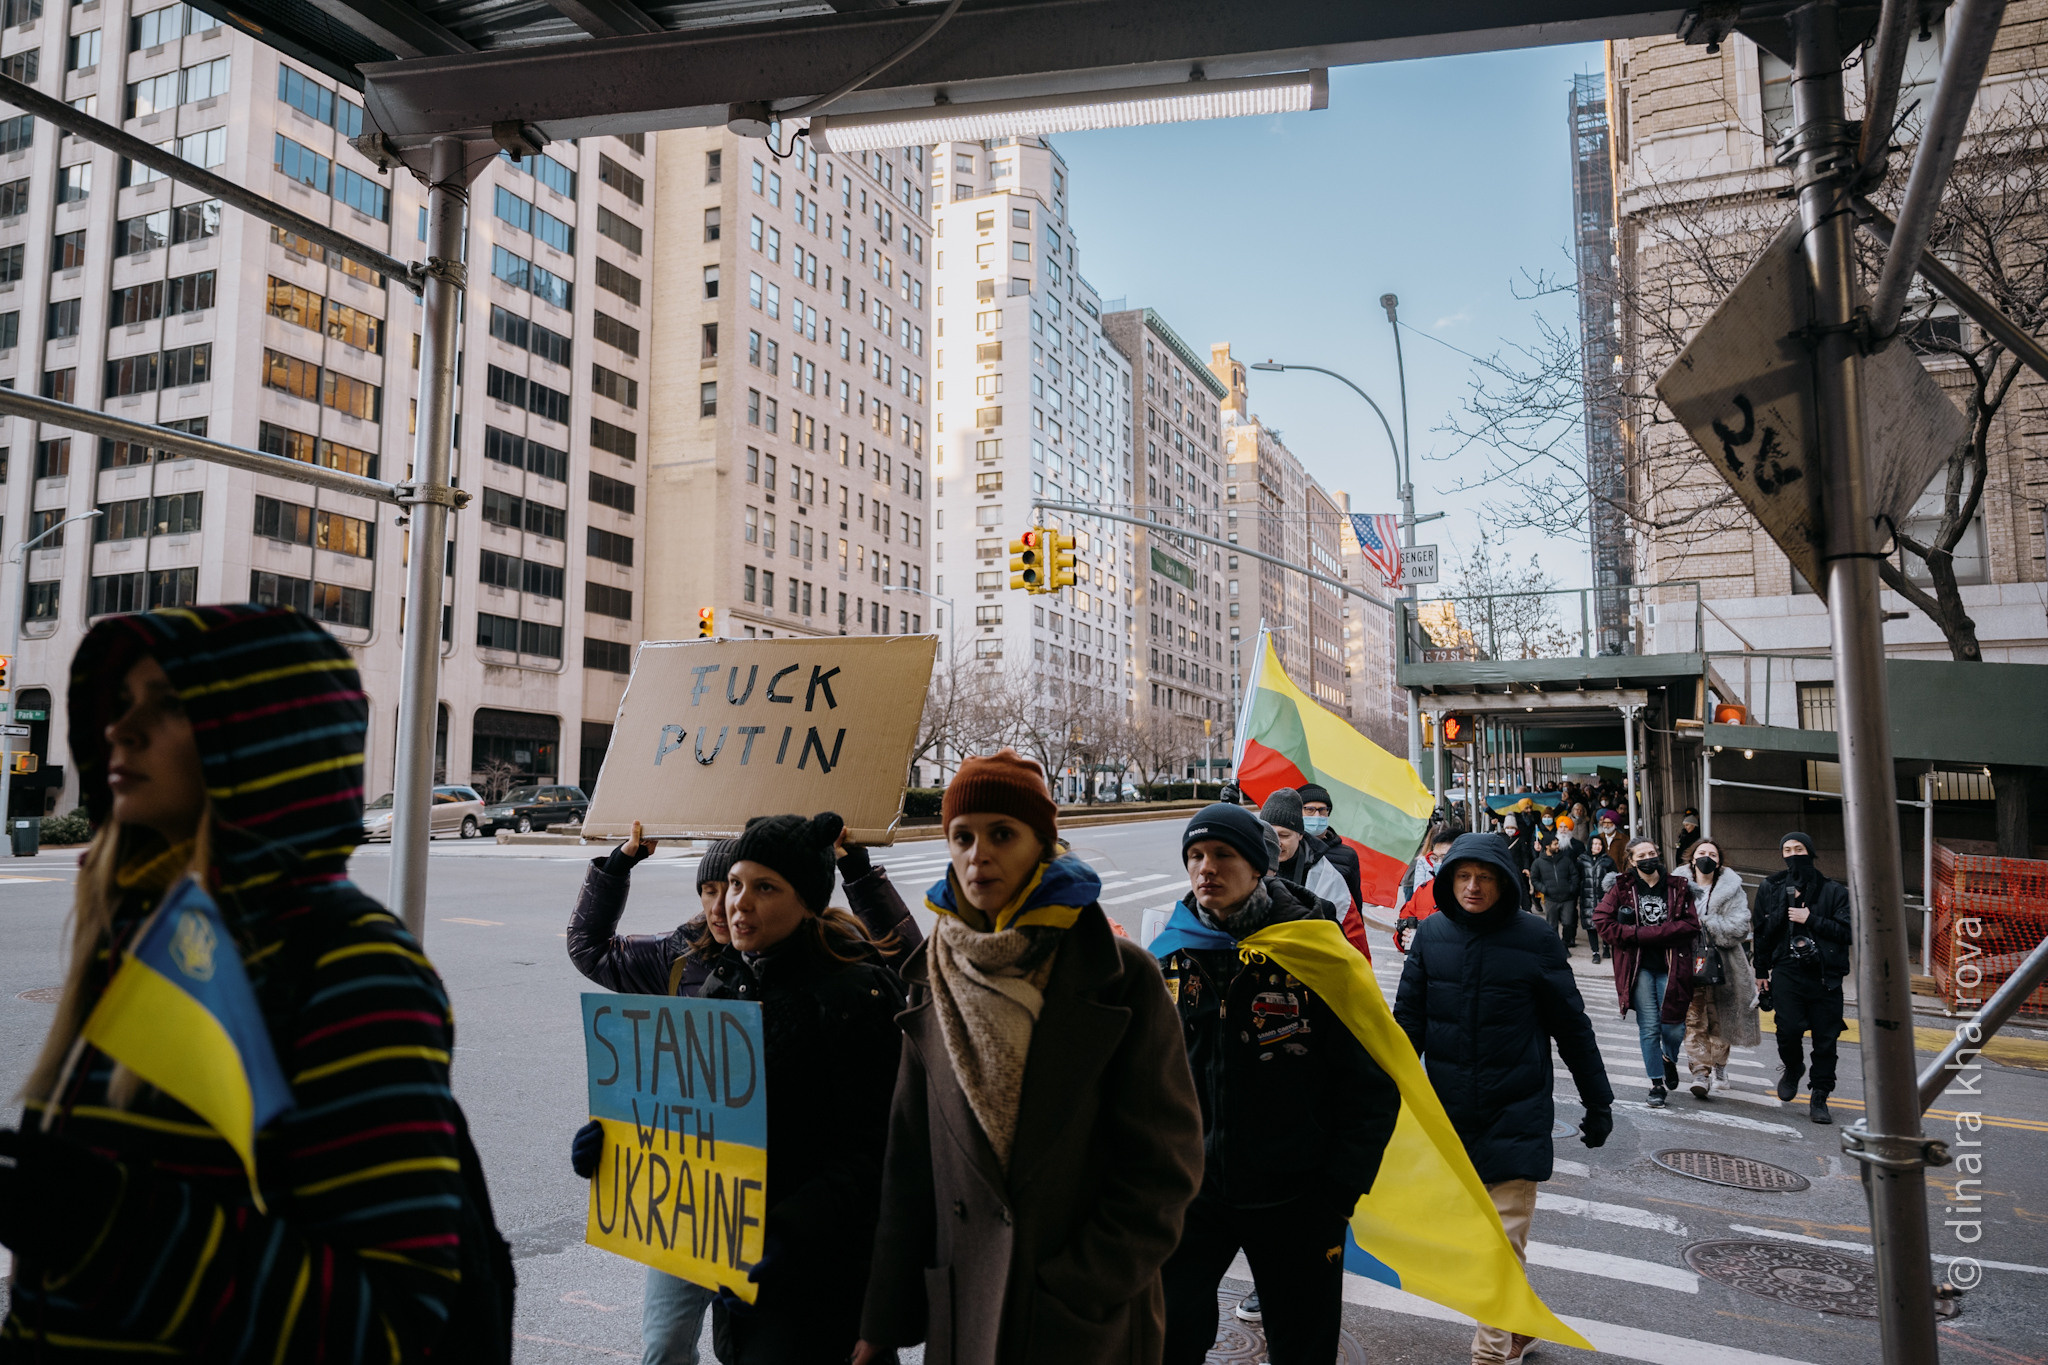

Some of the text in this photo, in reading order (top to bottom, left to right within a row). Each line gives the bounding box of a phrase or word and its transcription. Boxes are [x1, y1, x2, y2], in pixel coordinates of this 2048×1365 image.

[1400, 551, 1434, 564] SENGER
[1412, 565, 1434, 578] ONLY
[1435, 651, 1447, 661] 79
[1450, 651, 1460, 661] St
[691, 663, 840, 711] FUCK
[18, 711, 33, 719] Park
[654, 724, 846, 773] PUTIN
[593, 1005, 757, 1109] STAND
[632, 1098, 715, 1161] WITH
[595, 1144, 763, 1272] UKRAINE
